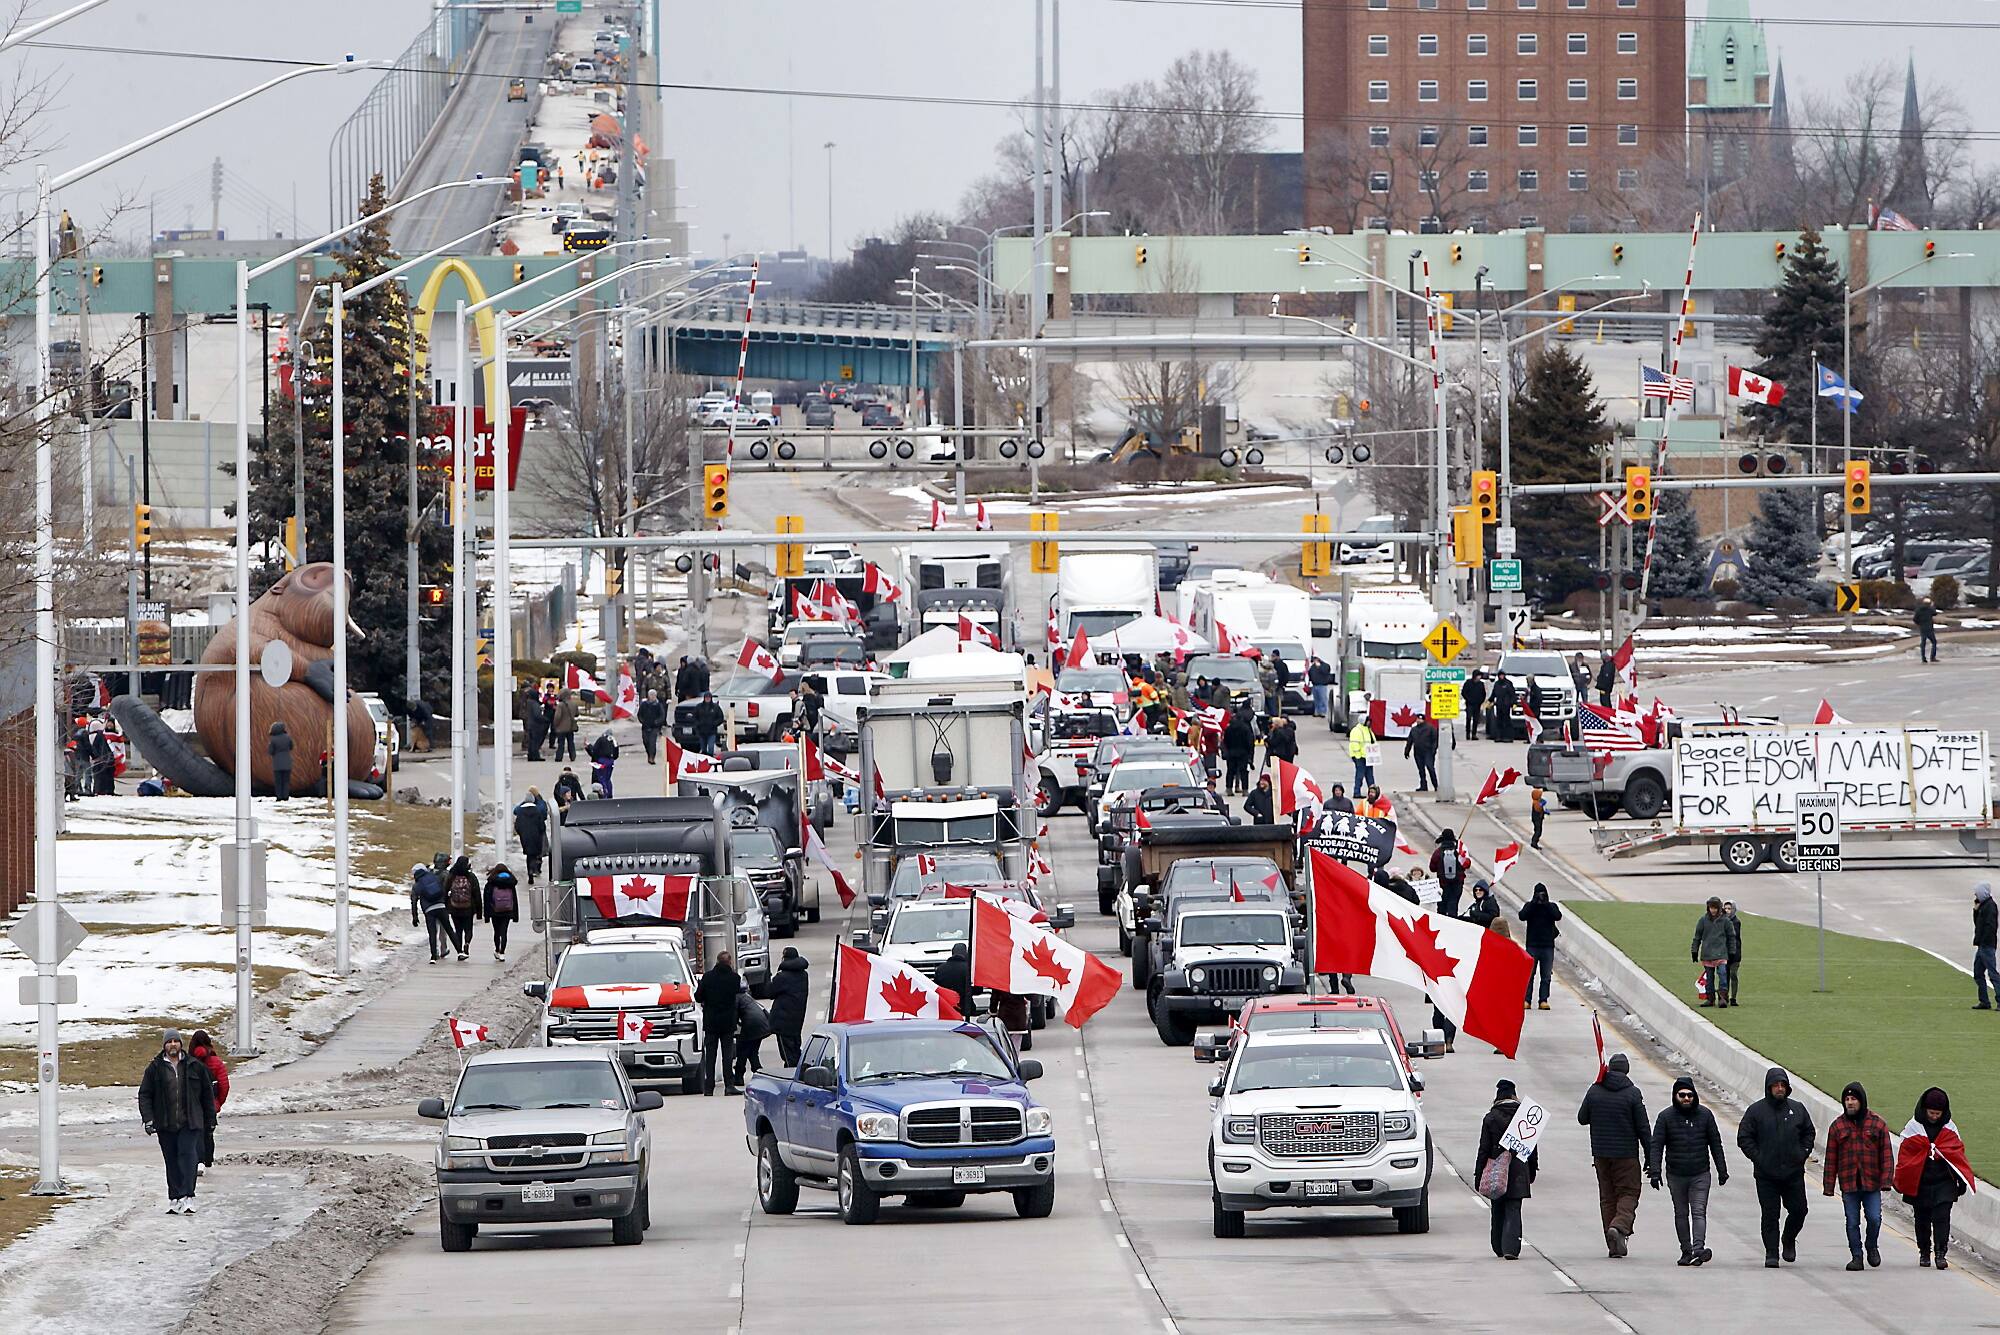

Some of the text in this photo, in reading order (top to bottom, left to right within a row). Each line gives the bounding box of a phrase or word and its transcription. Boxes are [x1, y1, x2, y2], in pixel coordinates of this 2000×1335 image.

[148, 602, 165, 612] MAC
[137, 612, 166, 622] ACON!
[1425, 670, 1458, 682] College
[1679, 739, 1812, 763] Peace LOVE
[1681, 757, 1818, 788] FREEDOM
[1679, 792, 1795, 817] FOR AL
[1799, 798, 1837, 808] MAXIMUM
[1801, 812, 1835, 837] 50
[1308, 839, 1379, 856] TRUDEAU TO THE
[1803, 846, 1835, 857] km/h
[1338, 848, 1378, 863] STATION
[1799, 859, 1839, 871] BEGINS
[1295, 1121, 1344, 1135] GMC
